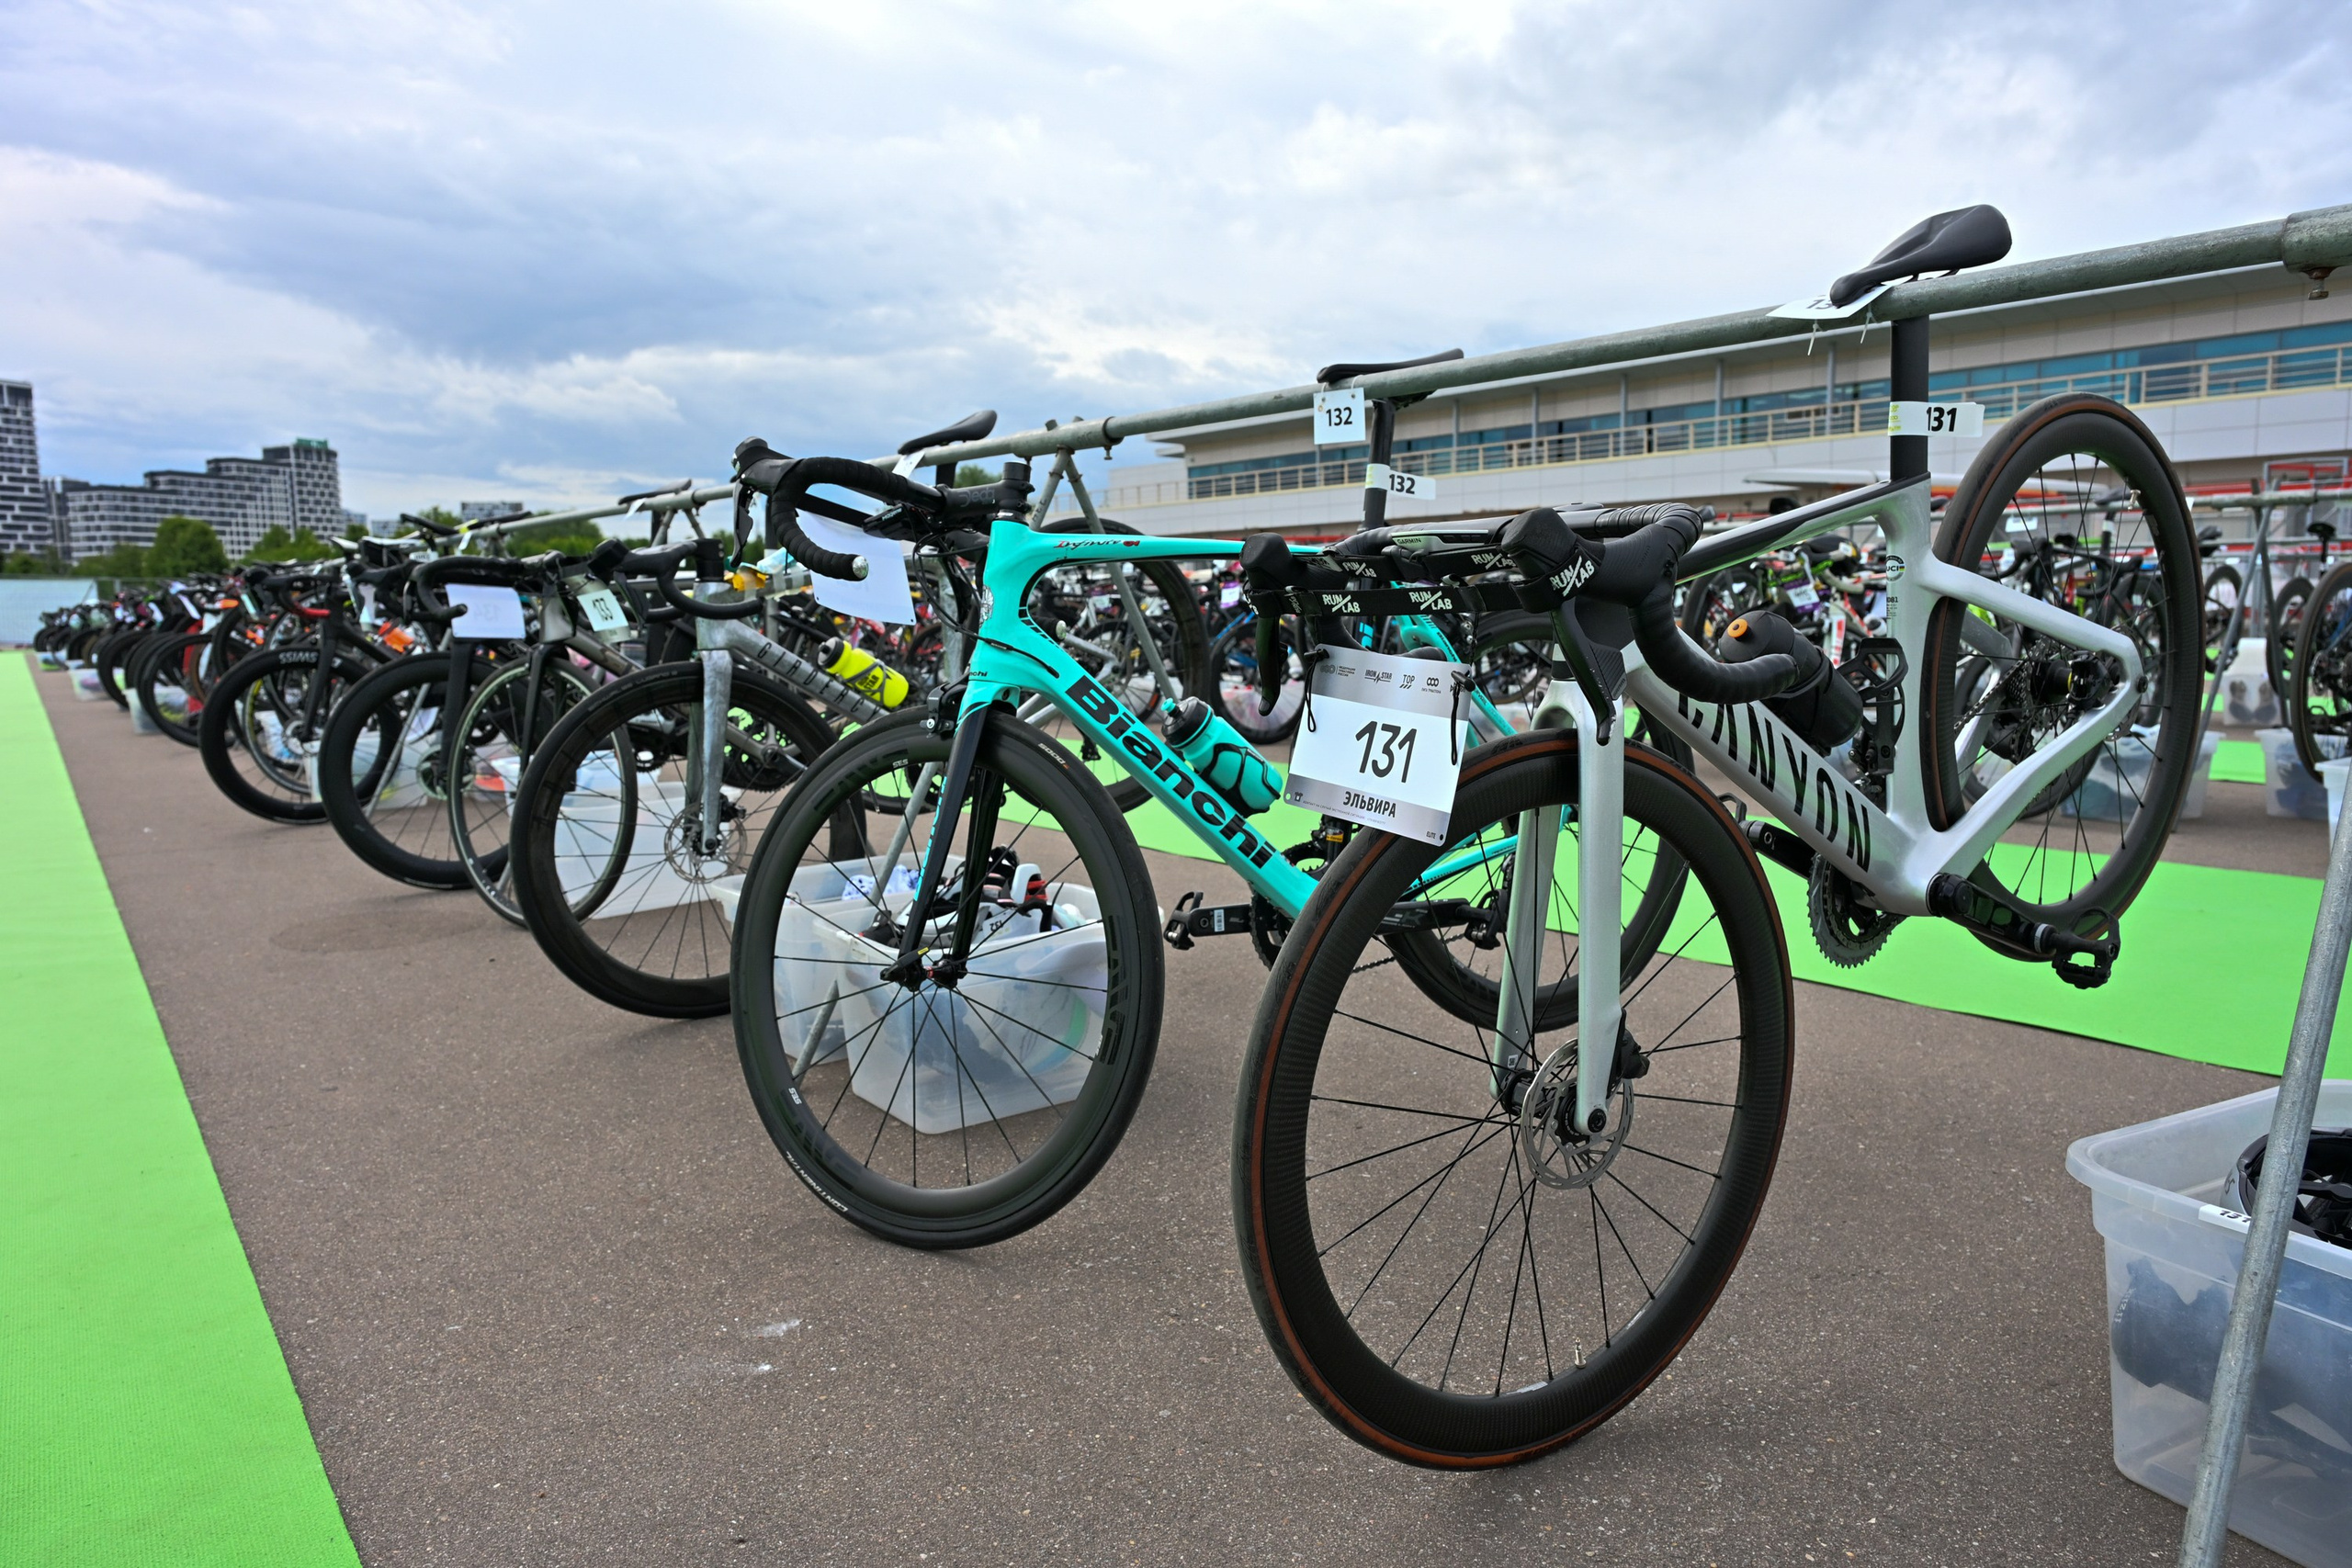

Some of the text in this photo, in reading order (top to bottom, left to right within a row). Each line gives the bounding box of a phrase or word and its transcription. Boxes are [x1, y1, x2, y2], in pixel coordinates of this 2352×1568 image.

[1326, 407, 1353, 426] 132
[1926, 406, 1958, 433] 131
[1388, 474, 1416, 495] 132
[1363, 566, 1378, 579] LAB
[1574, 559, 1596, 588] LAB
[1321, 594, 1361, 614] RUN LAB
[1408, 591, 1453, 611] RUN LAB
[1364, 669, 1393, 681] IRON STAR
[1402, 673, 1416, 685] TOP
[1355, 720, 1418, 784] 131
[891, 759, 909, 769] SES
[1065, 675, 1277, 869] Bianchi
[1342, 791, 1397, 818] ЭЛЬВИРА
[788, 1087, 802, 1105] SES
[786, 1150, 849, 1213] CONTINENTAL
